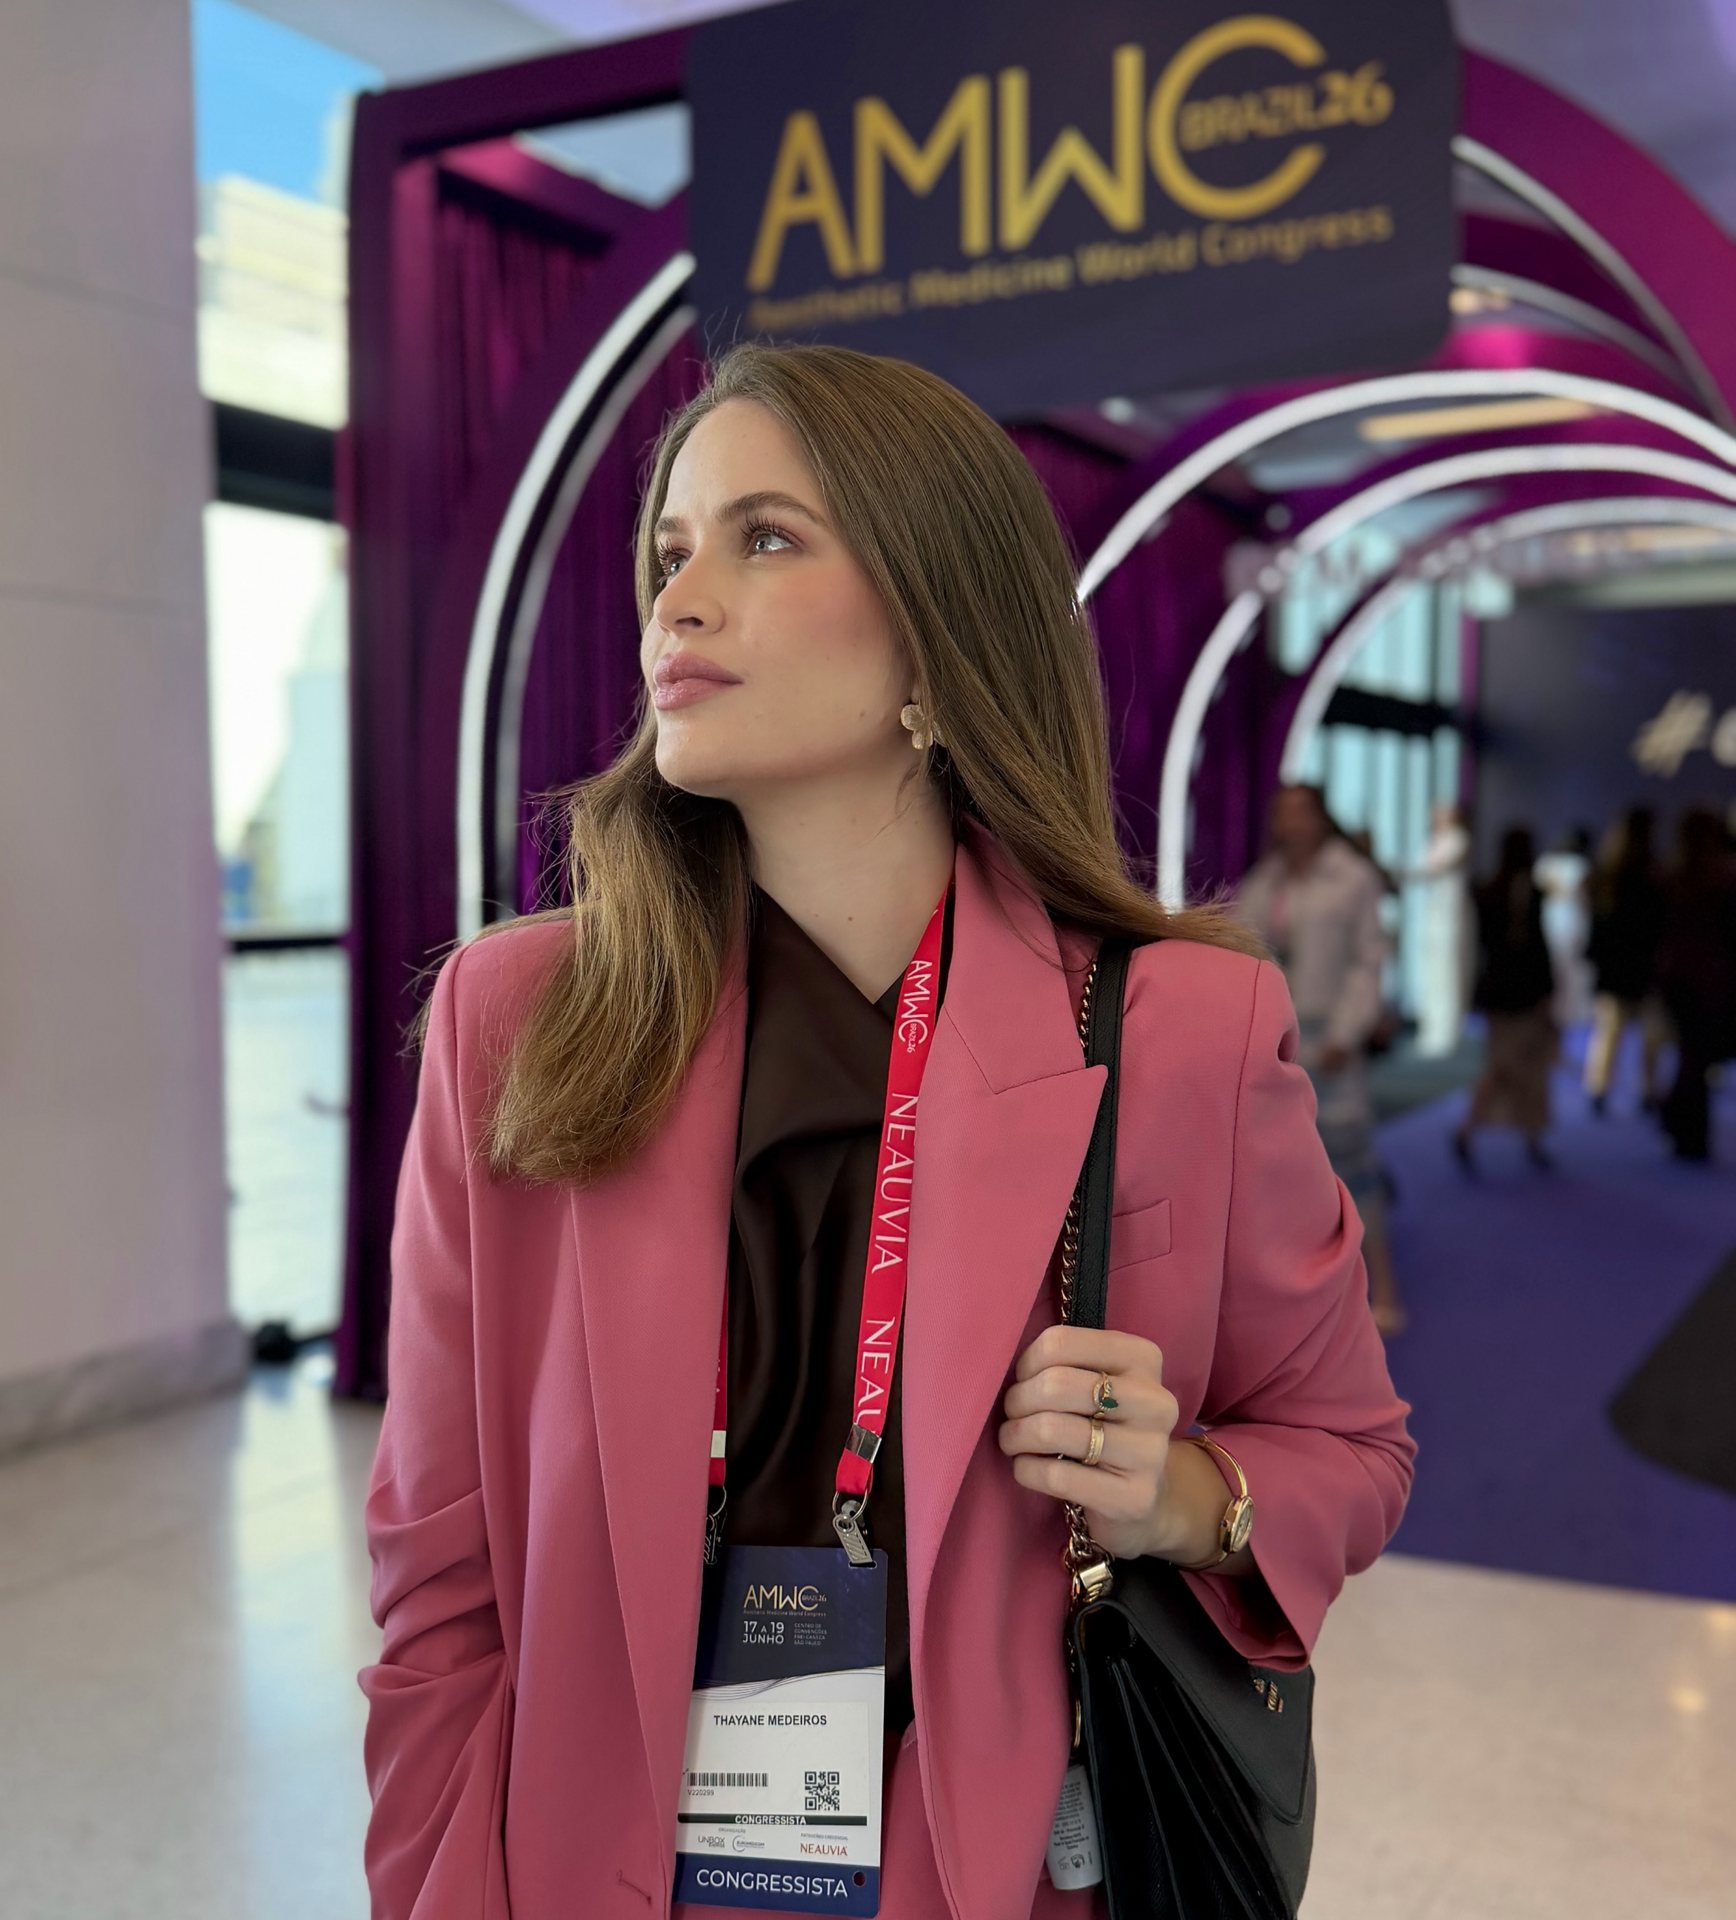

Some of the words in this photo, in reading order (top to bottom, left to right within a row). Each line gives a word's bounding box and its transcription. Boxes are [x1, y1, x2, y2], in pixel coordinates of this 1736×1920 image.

[747, 15, 1326, 291] AMWC
[908, 252, 1074, 308] Medicine
[1077, 227, 1196, 284] World
[1201, 205, 1394, 266] Congress
[898, 959, 933, 1044] AMWC
[871, 1092, 919, 1274] NEAUVIA
[743, 1584, 819, 1611] AMWC
[743, 1621, 758, 1633] 17
[770, 1621, 785, 1634] 19
[743, 1633, 785, 1645] JUNHO
[714, 1714, 765, 1725] THAYANE
[768, 1714, 827, 1725] MEDEIROS
[735, 1815, 807, 1825] CONGRESSISTA
[698, 1836, 725, 1844] UNBOX
[800, 1843, 848, 1857] NEAUVIA
[696, 1869, 848, 1897] CONGRESSISTA
